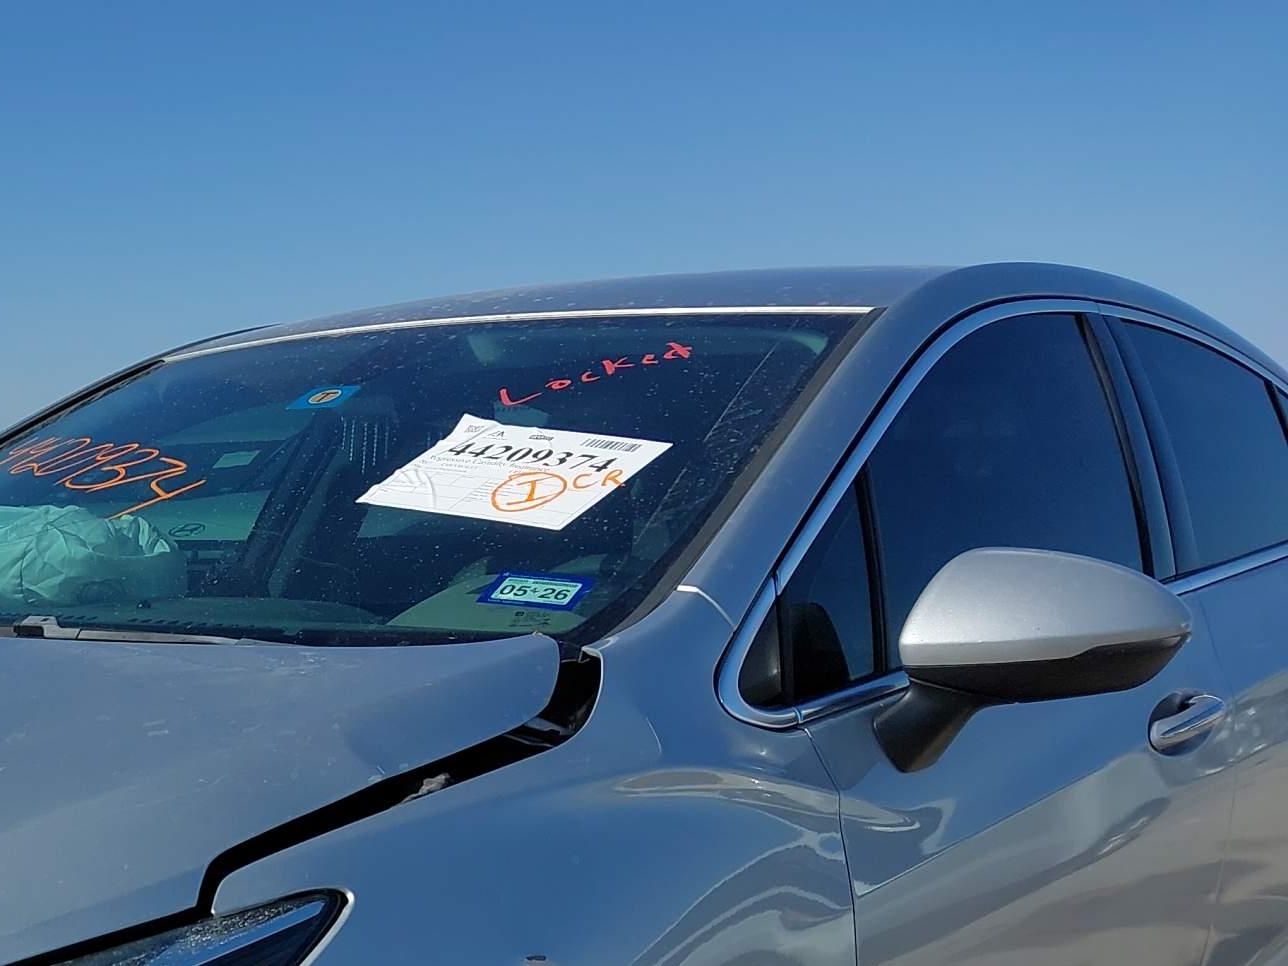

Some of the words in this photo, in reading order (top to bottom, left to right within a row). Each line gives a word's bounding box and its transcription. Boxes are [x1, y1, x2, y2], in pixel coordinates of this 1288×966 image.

[447, 442, 618, 472] 44209374
[499, 584, 532, 597] 05
[537, 587, 571, 601] 26
